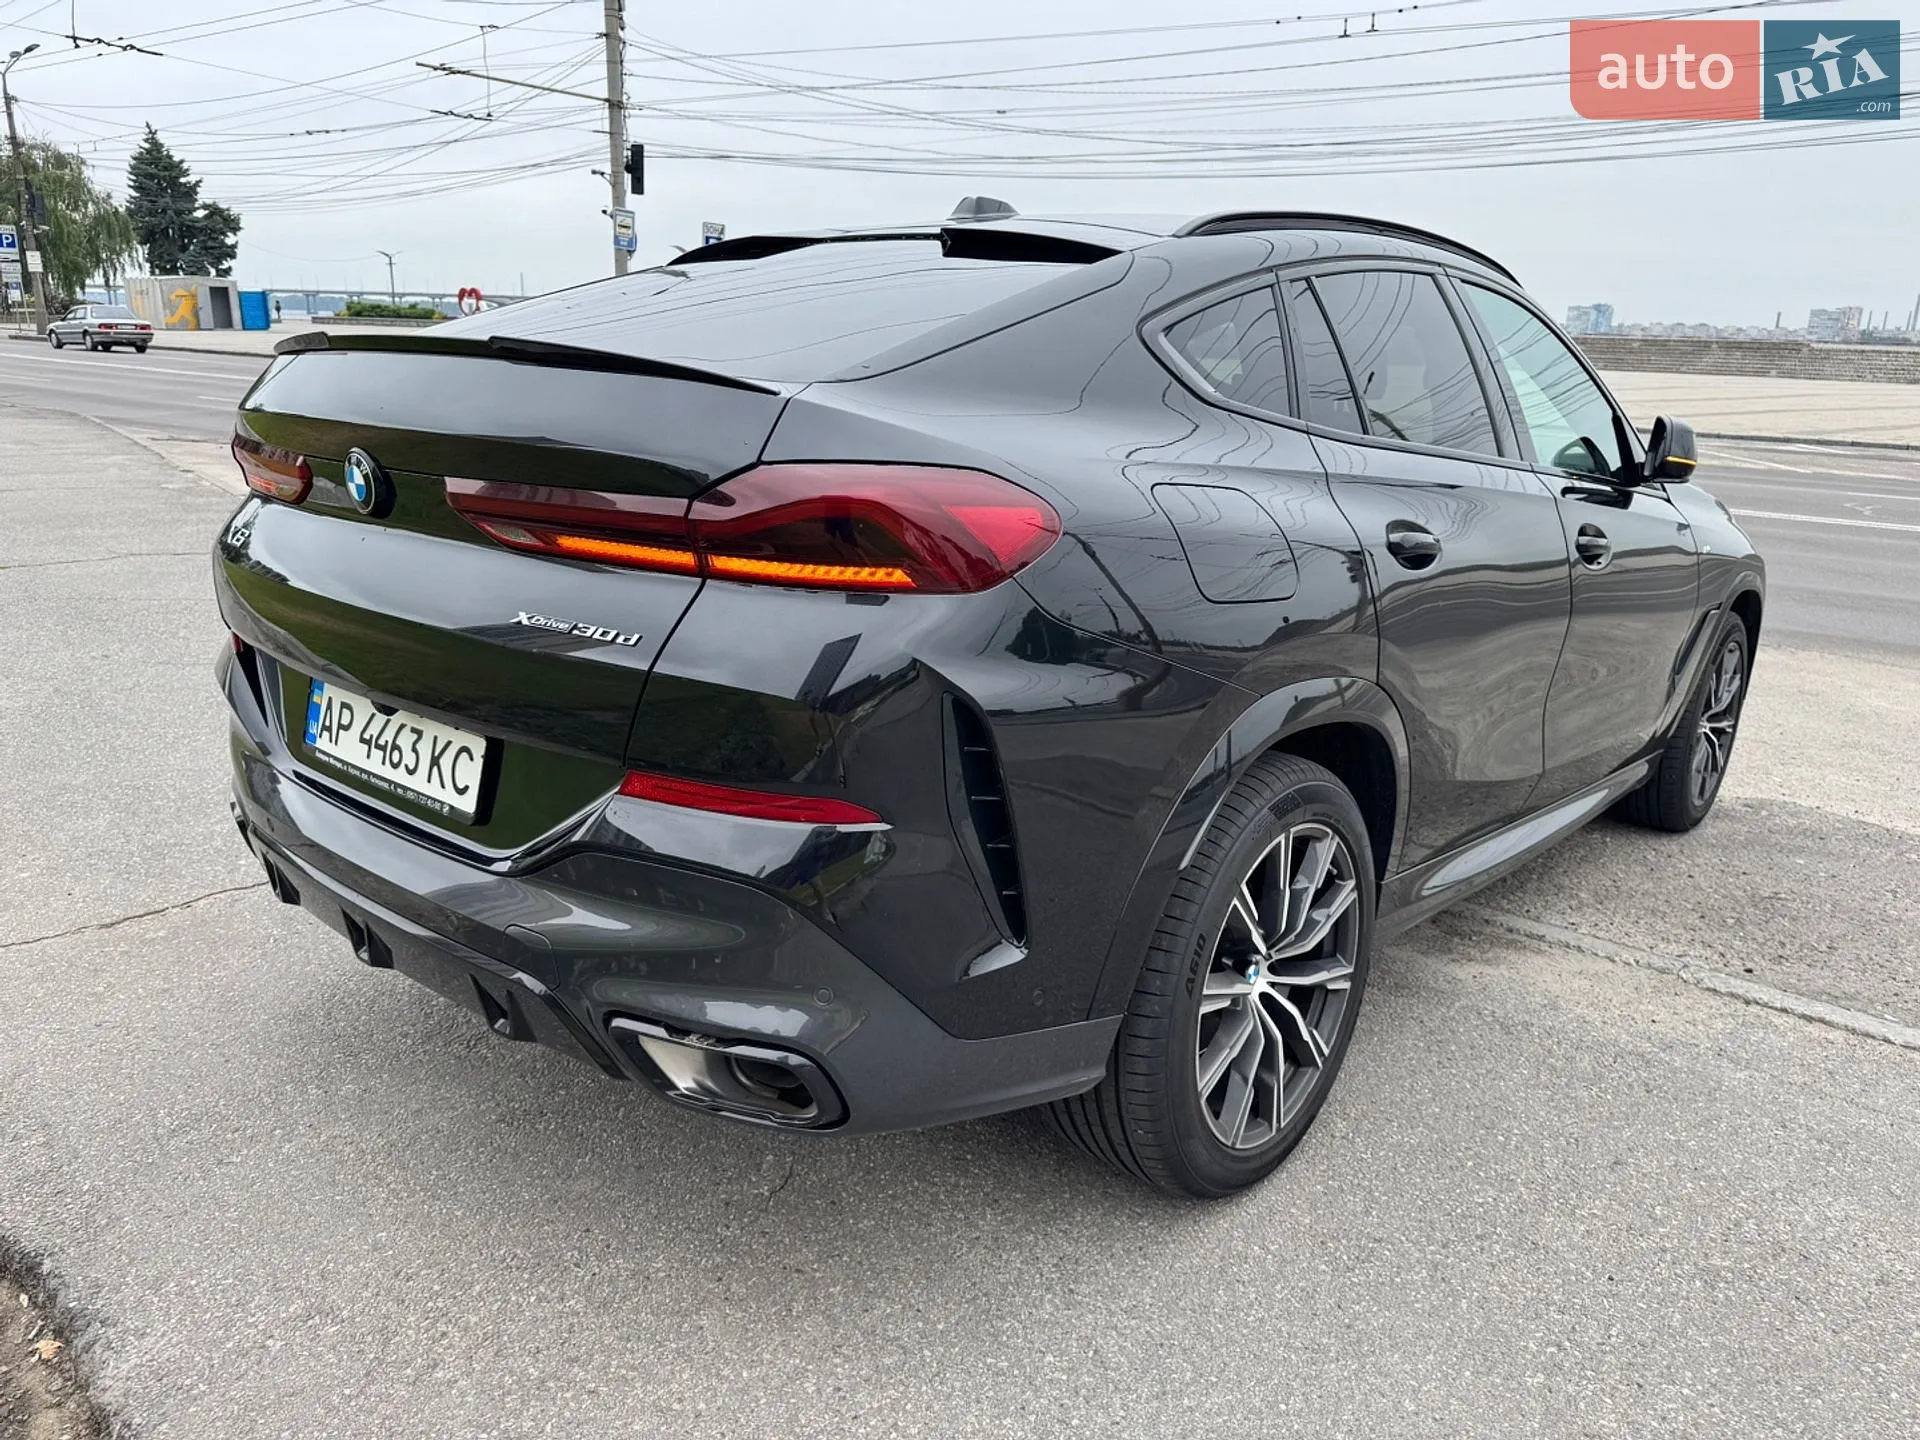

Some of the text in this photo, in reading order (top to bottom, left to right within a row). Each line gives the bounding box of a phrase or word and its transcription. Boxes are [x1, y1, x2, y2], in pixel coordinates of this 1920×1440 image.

[2, 235, 12, 248] P
[572, 623, 641, 647] 30d
[318, 696, 475, 797] AP 4463 KC
